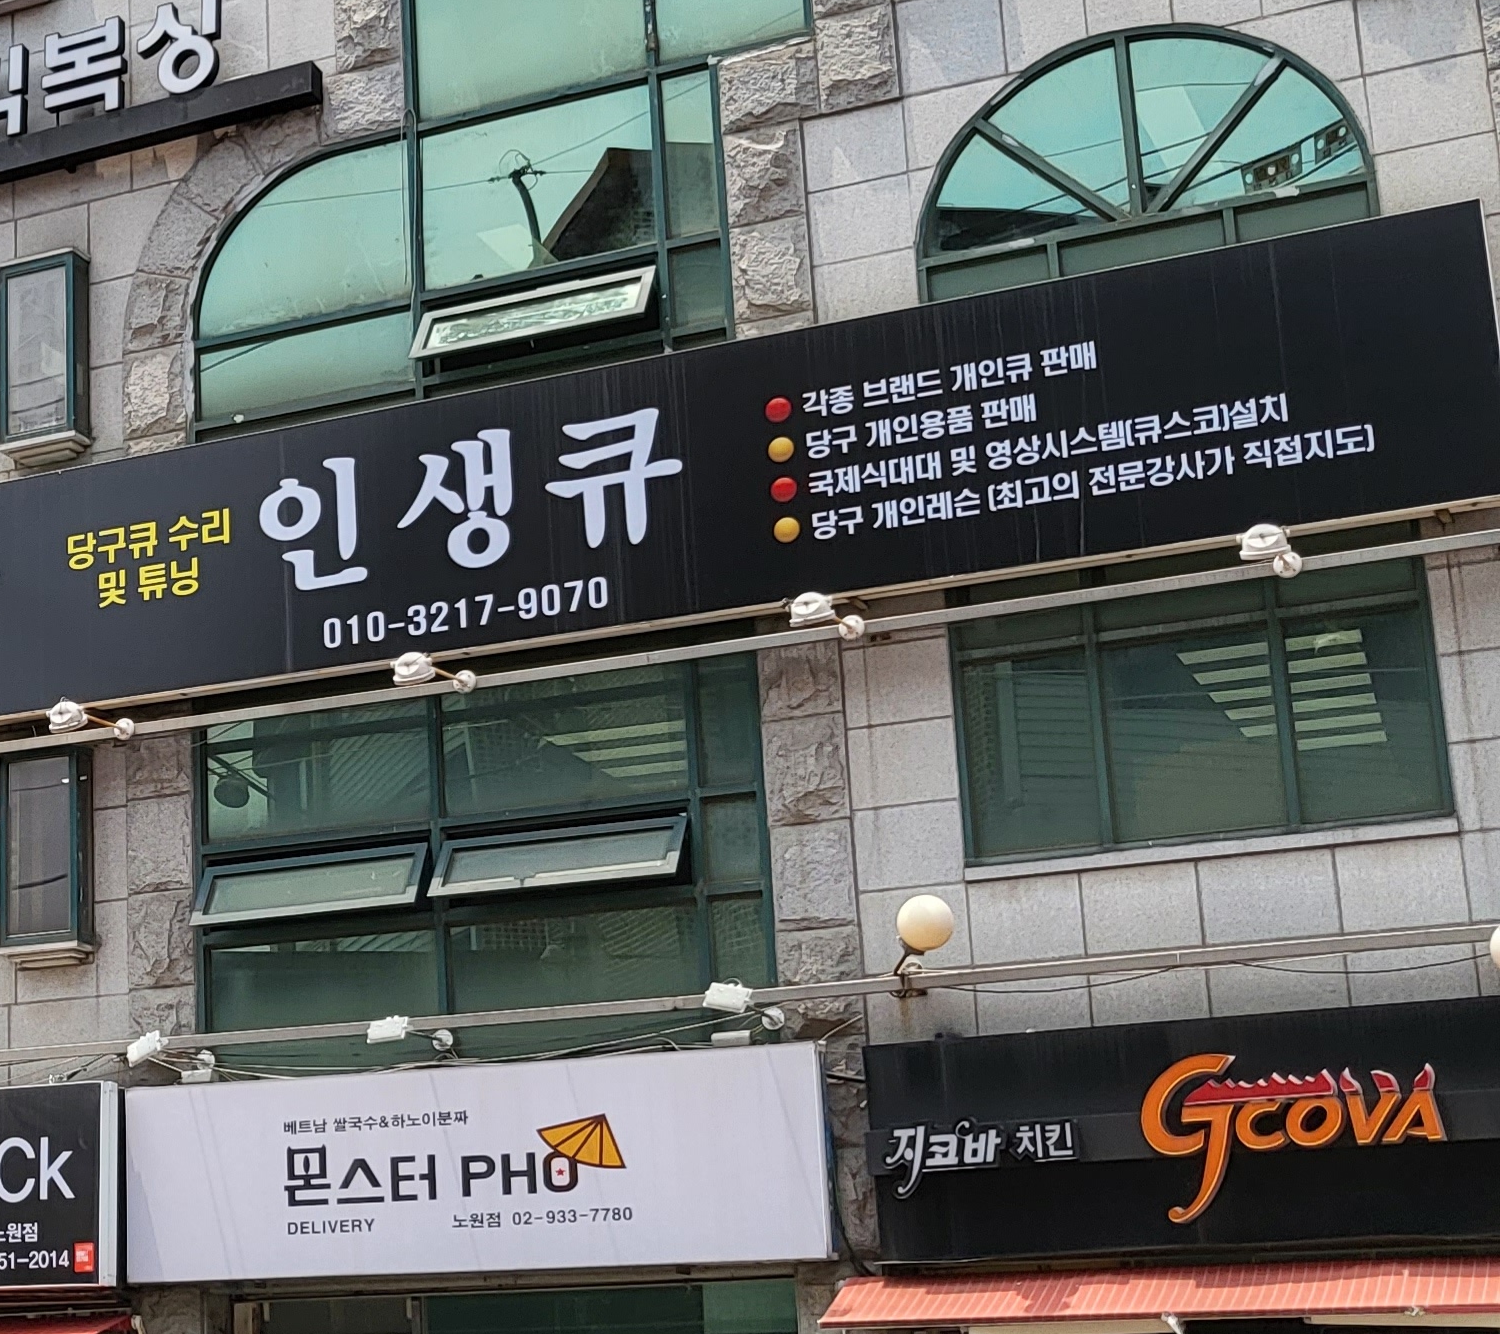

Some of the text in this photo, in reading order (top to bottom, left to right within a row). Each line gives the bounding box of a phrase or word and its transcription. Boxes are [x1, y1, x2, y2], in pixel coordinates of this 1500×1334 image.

[801, 340, 1098, 419] 각종 브랜드 개인큐 판매
[805, 394, 1037, 459] 당구 개인용품 판매
[807, 450, 943, 499] 국제식대대
[950, 446, 977, 479] 및
[811, 424, 1375, 541] 당구 개인레슨 (최고의 전문강사가 직접지도)
[66, 507, 232, 570] 당구큐 수리
[97, 557, 200, 609] 및 튜닝
[322, 576, 609, 649] 010-3217-9070
[283, 1110, 469, 1135] 베트남 쌀국수&하노이분짜
[283, 1145, 579, 1208] 몬스터 PHO
[885, 1120, 1076, 1199] 지코바 치킨
[286, 1218, 376, 1236] DELIVERY
[451, 1205, 633, 1230] 노원점 02-933-7780
